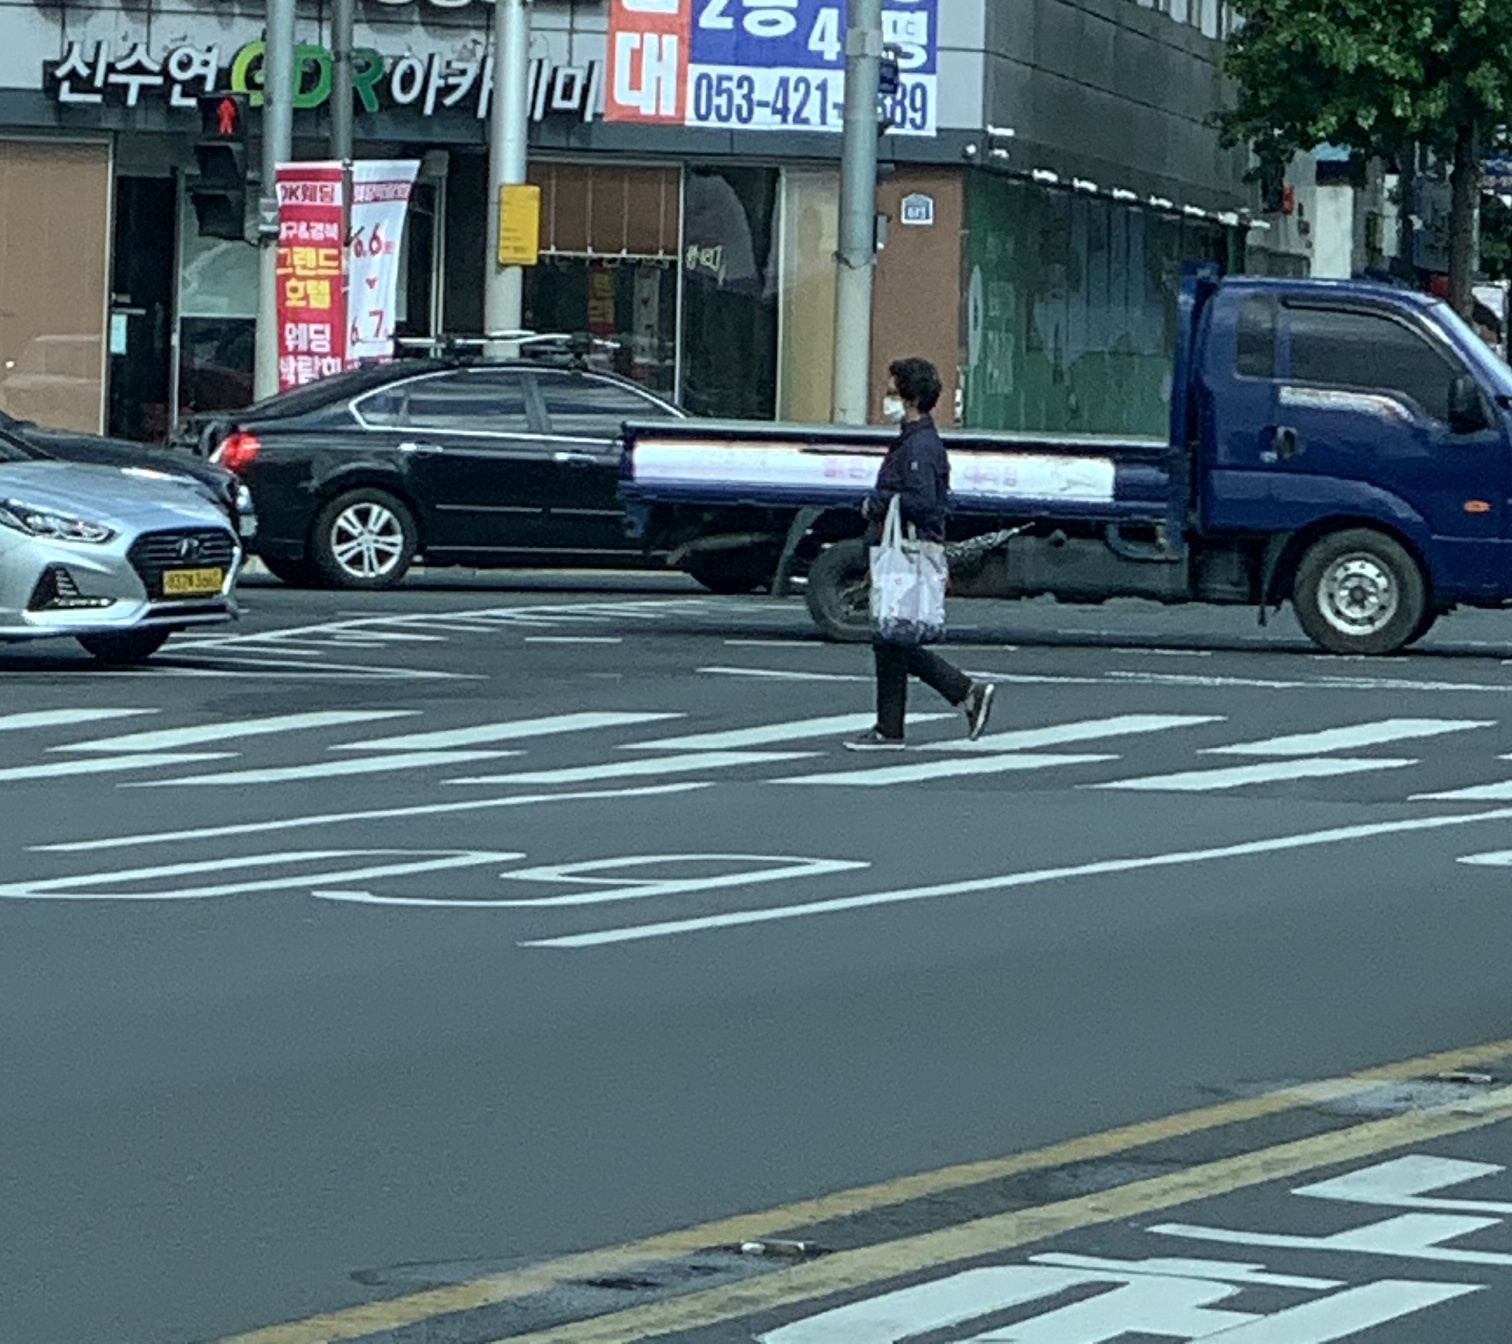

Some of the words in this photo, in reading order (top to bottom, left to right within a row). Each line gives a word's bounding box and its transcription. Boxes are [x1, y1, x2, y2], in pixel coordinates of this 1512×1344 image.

[276, 247, 340, 276] 그랜드
[285, 279, 332, 309] 호텔
[285, 322, 332, 353] 웨딩
